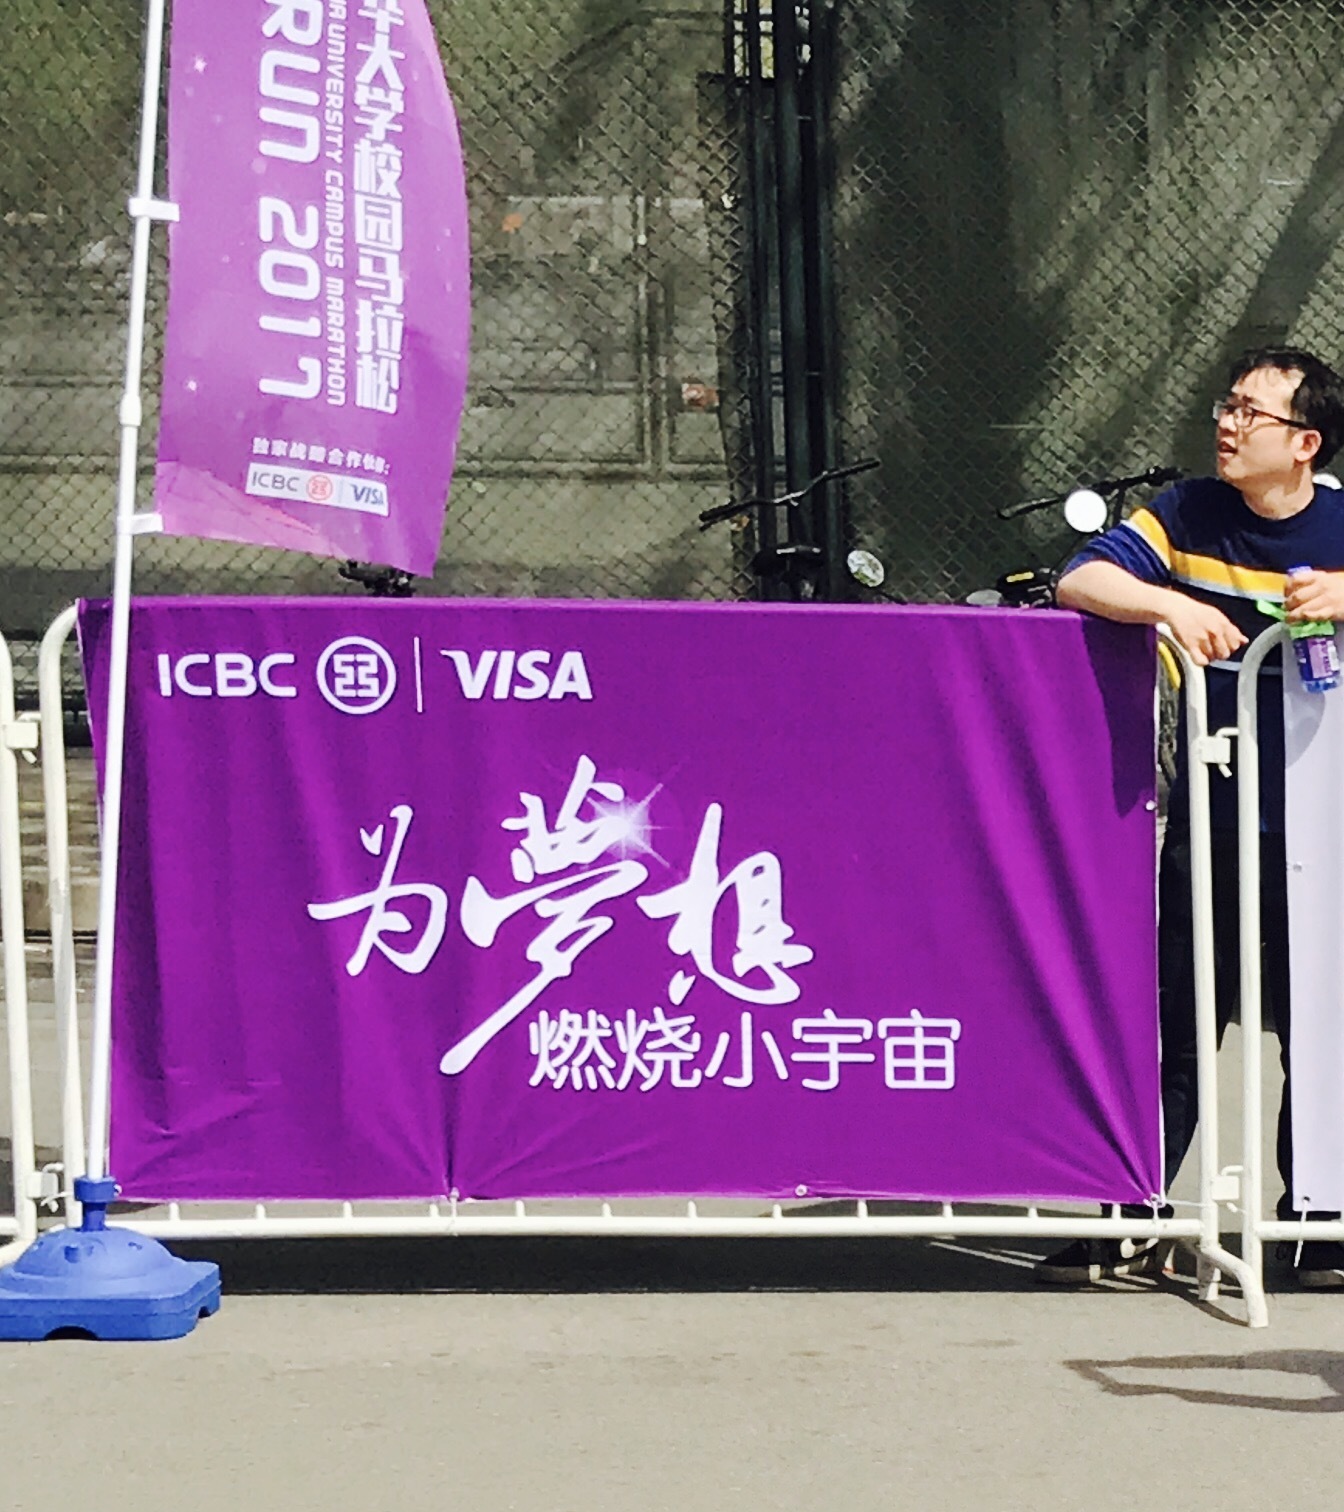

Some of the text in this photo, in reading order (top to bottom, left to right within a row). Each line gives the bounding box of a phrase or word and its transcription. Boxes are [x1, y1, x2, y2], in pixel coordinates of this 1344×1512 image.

[325, 22, 347, 163] UNIVERSITY
[324, 169, 344, 269] CAMPUS
[258, 196, 322, 401] 2017
[325, 276, 346, 407] MARATHON
[251, 471, 300, 492] ICBC
[158, 649, 593, 700] ICBC VISA
[528, 1007, 962, 1092] 燃烧小宇宙
